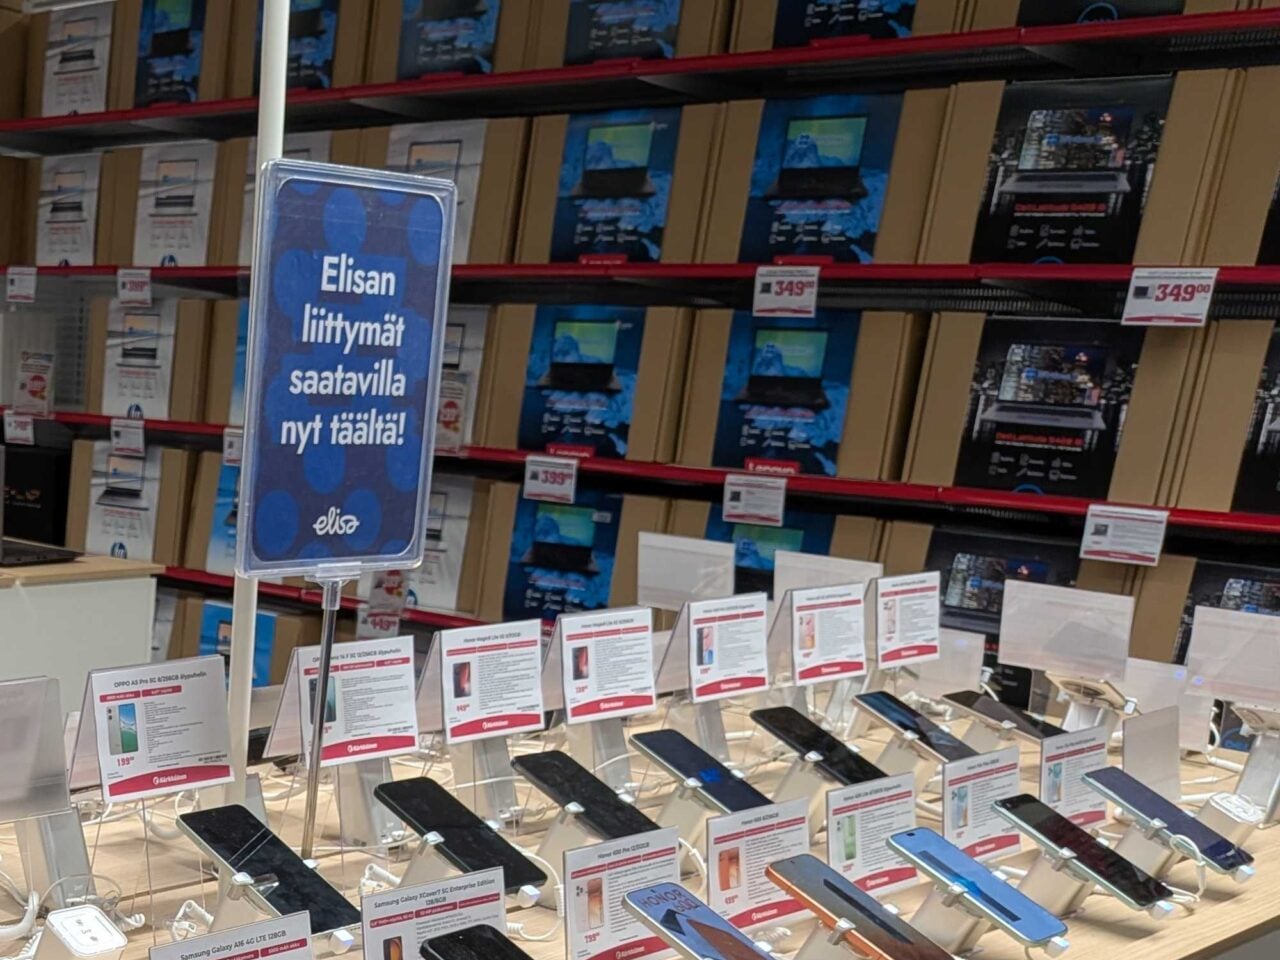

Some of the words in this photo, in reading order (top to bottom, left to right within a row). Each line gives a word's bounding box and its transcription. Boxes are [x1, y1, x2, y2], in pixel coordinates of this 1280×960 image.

[321, 254, 395, 296] Elisan
[302, 304, 405, 354] liittymät
[289, 359, 405, 397] saatavilla
[281, 414, 322, 454] nyt
[330, 409, 405, 446] täältä!
[373, 898, 399, 908] Samsung
[400, 894, 418, 903] Galaxy
[449, 882, 475, 893] Enterprise
[476, 878, 494, 886] Edition
[640, 889, 685, 908] HONOR
[179, 949, 210, 960] Samsung
[211, 943, 232, 954] Galaxy
[233, 939, 244, 948] A16
[245, 937, 254, 945] 4G
[255, 934, 266, 943] LTE
[267, 929, 286, 939] 128GB
